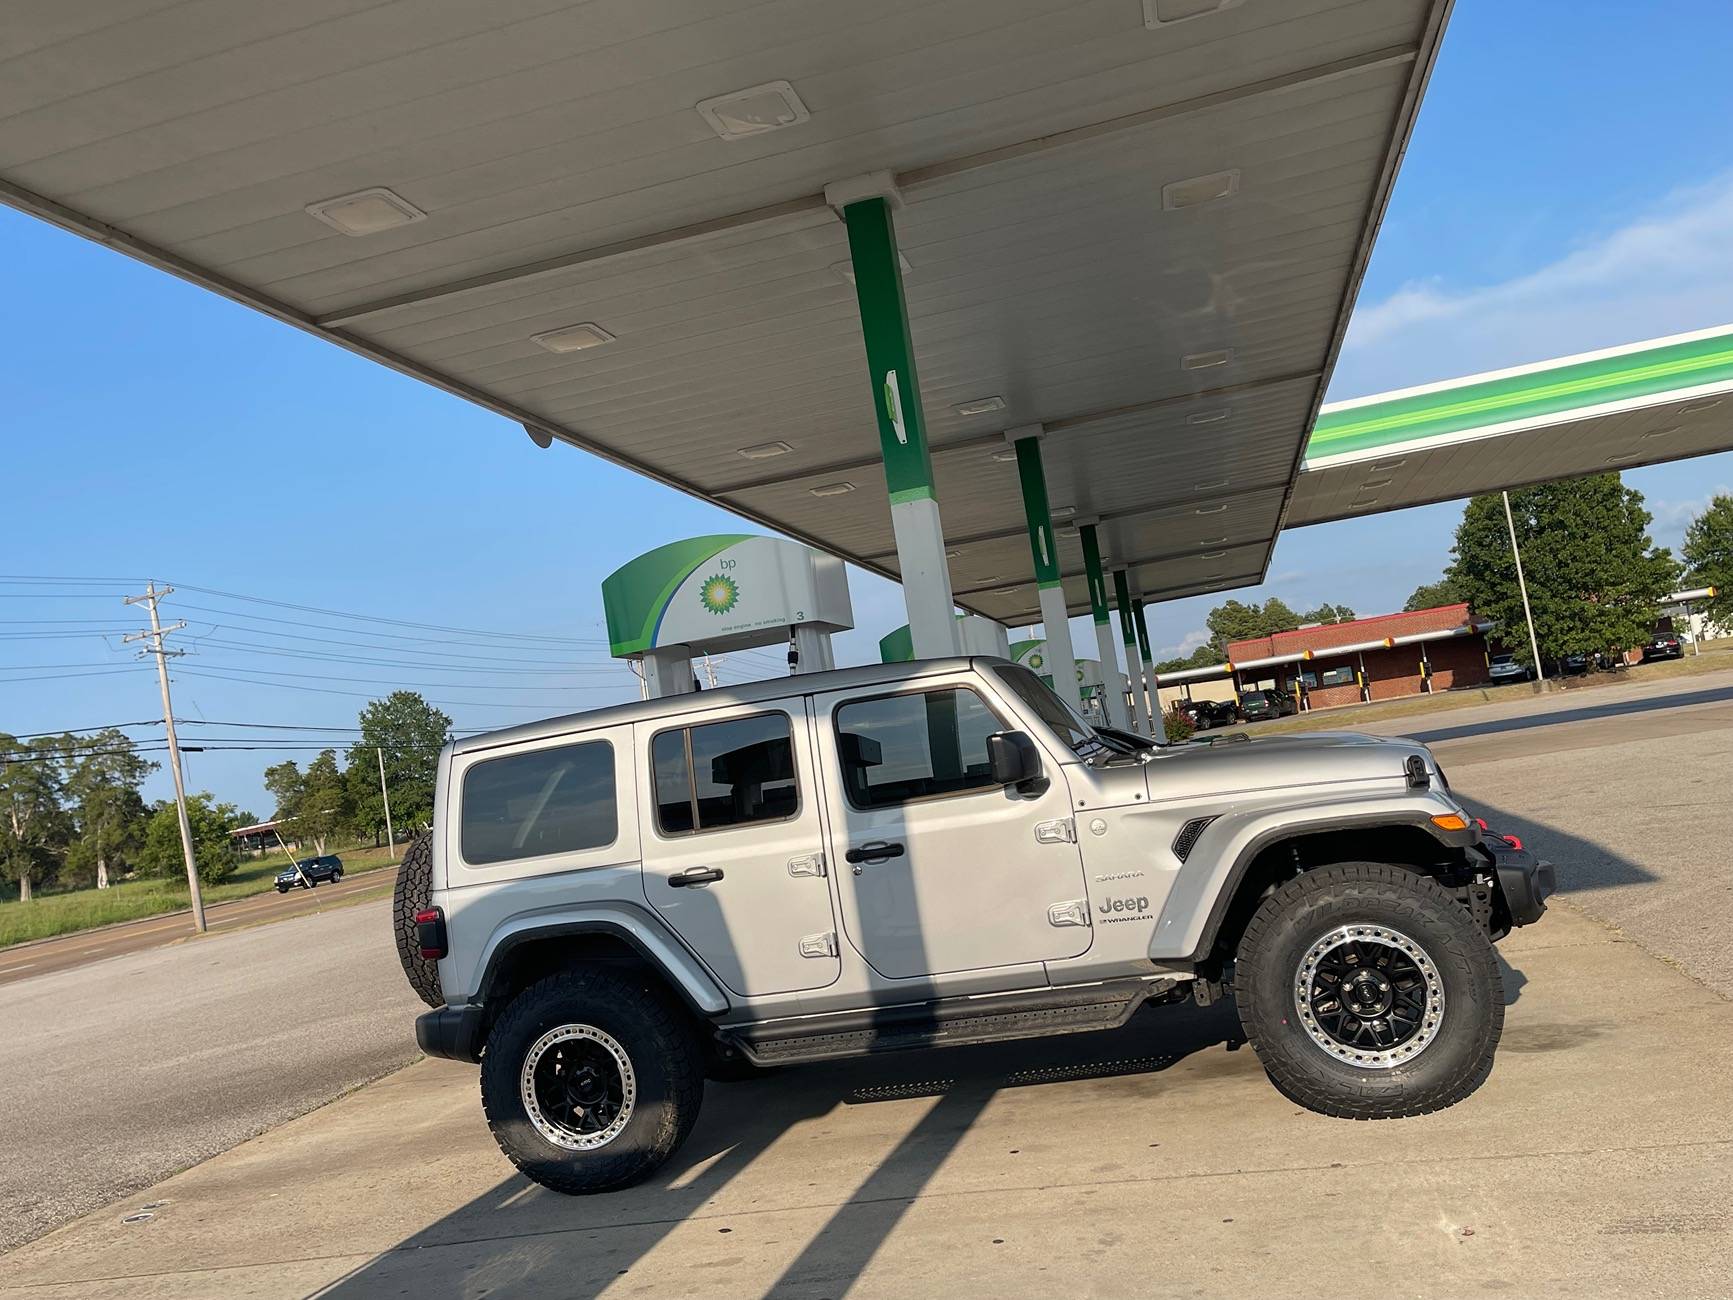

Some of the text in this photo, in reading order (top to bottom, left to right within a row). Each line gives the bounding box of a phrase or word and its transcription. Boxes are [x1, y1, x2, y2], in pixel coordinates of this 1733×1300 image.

[720, 559, 736, 571] bp
[763, 617, 786, 625] smoking
[796, 611, 805, 621] 3
[1099, 896, 1149, 913] Jeep
